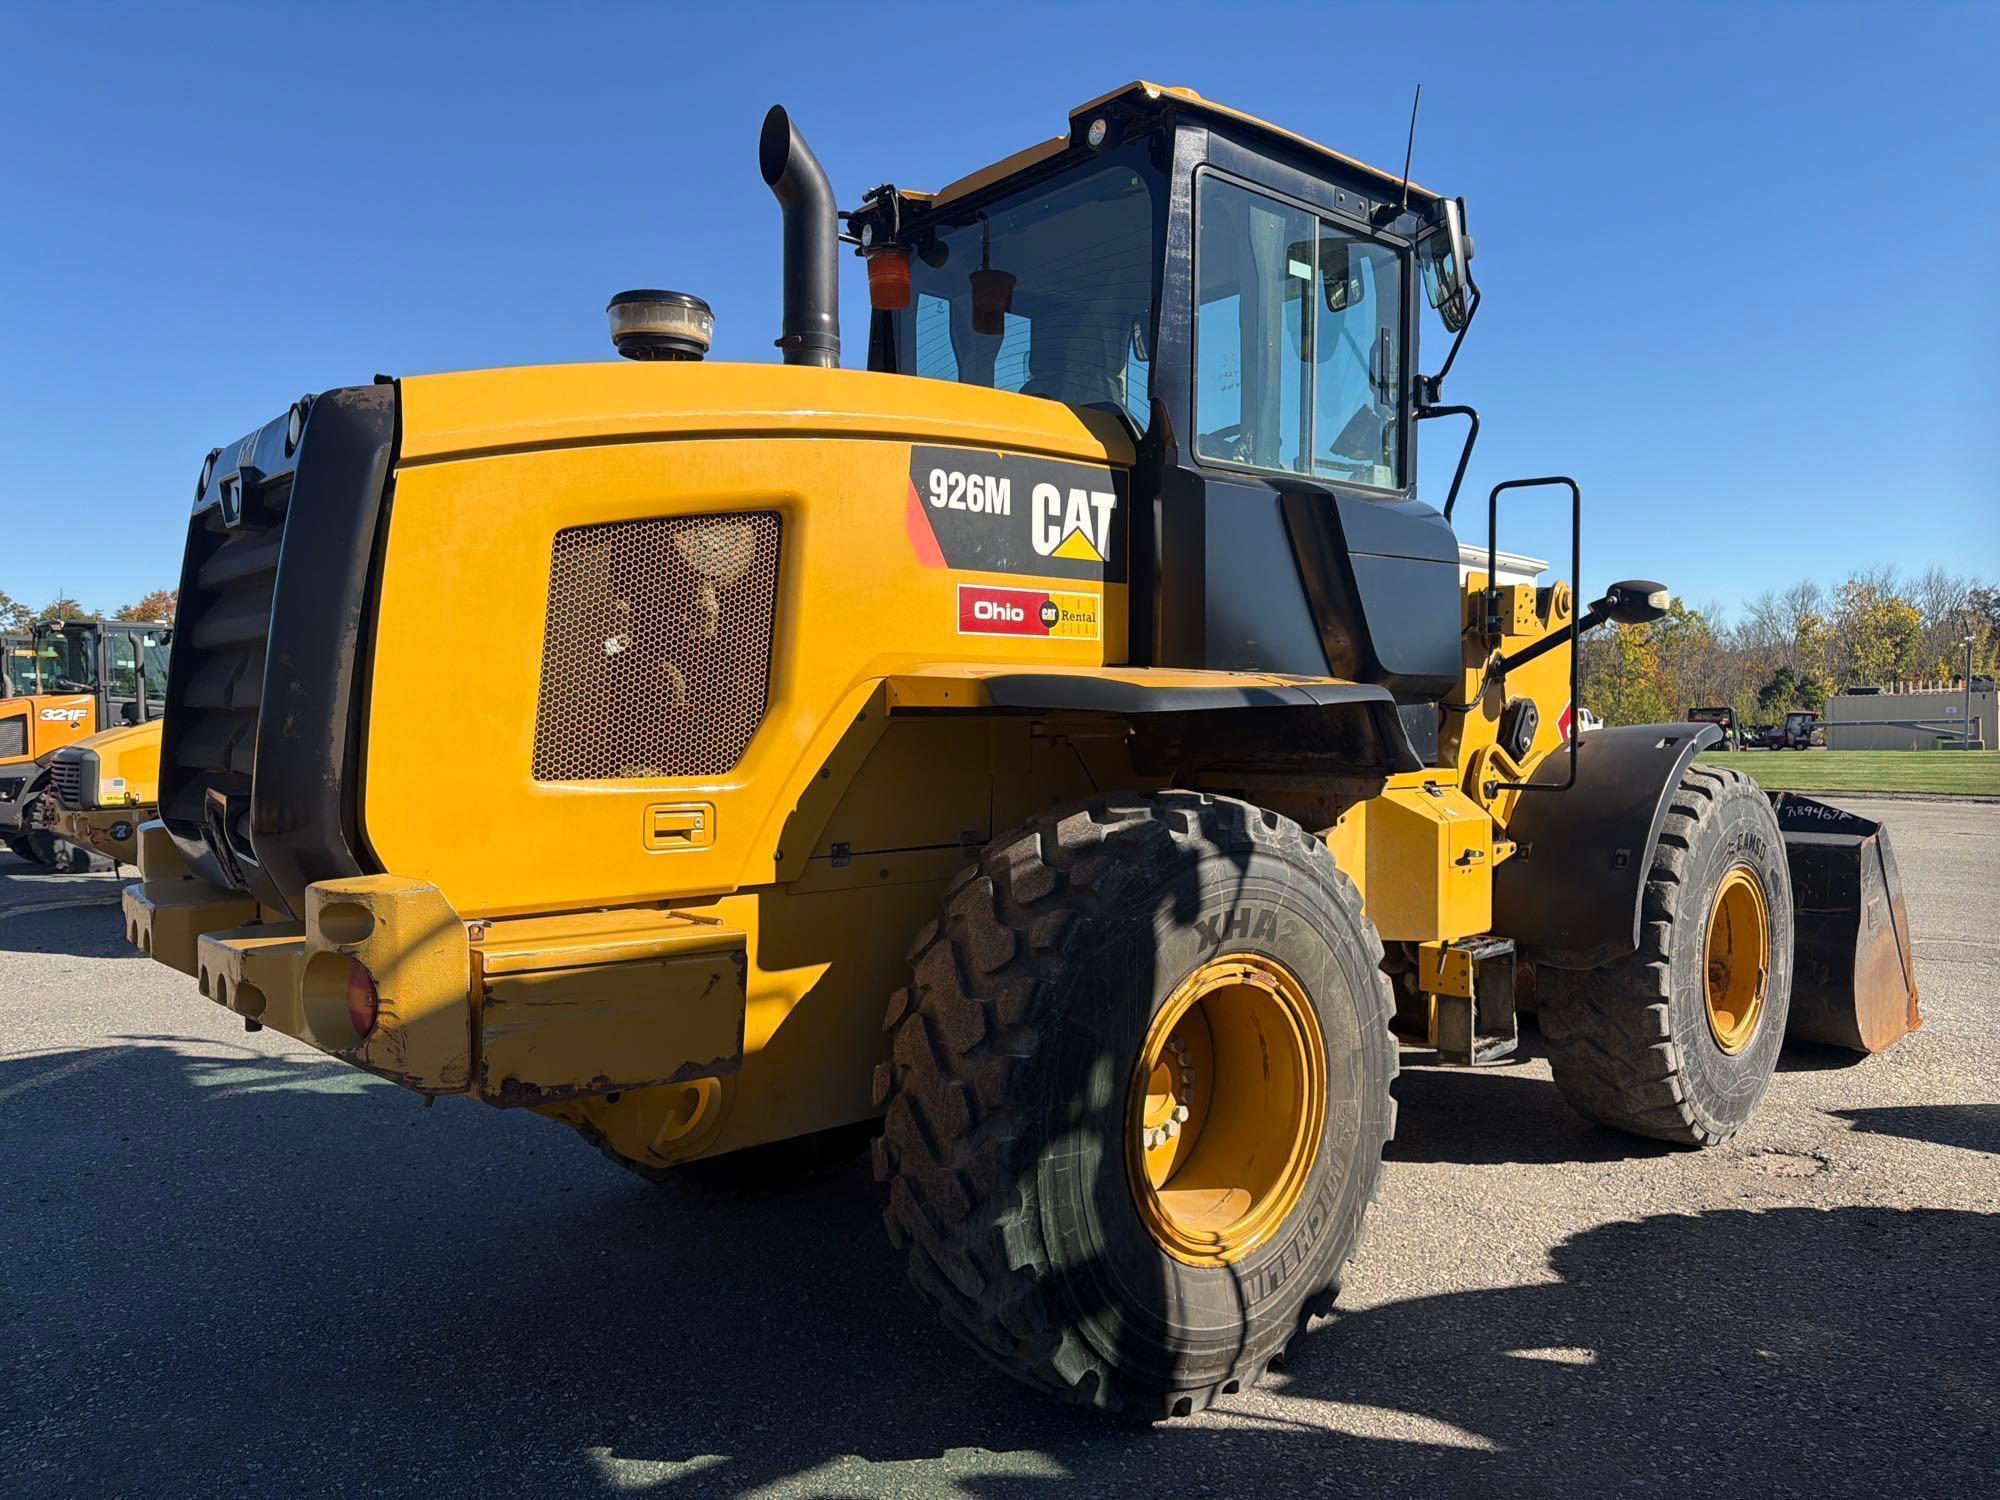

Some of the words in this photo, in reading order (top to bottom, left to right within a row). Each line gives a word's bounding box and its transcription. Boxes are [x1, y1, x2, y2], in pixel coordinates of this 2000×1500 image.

[929, 468, 1011, 516] 926M
[1031, 482, 1118, 562] CAT
[974, 600, 1025, 622] Ohio
[1041, 607, 1057, 621] CAT
[1061, 610, 1097, 623] Rental
[39, 708, 88, 721] 321F
[1737, 831, 1768, 861] CAMSO
[1242, 1153, 1346, 1305] MICHELIN
